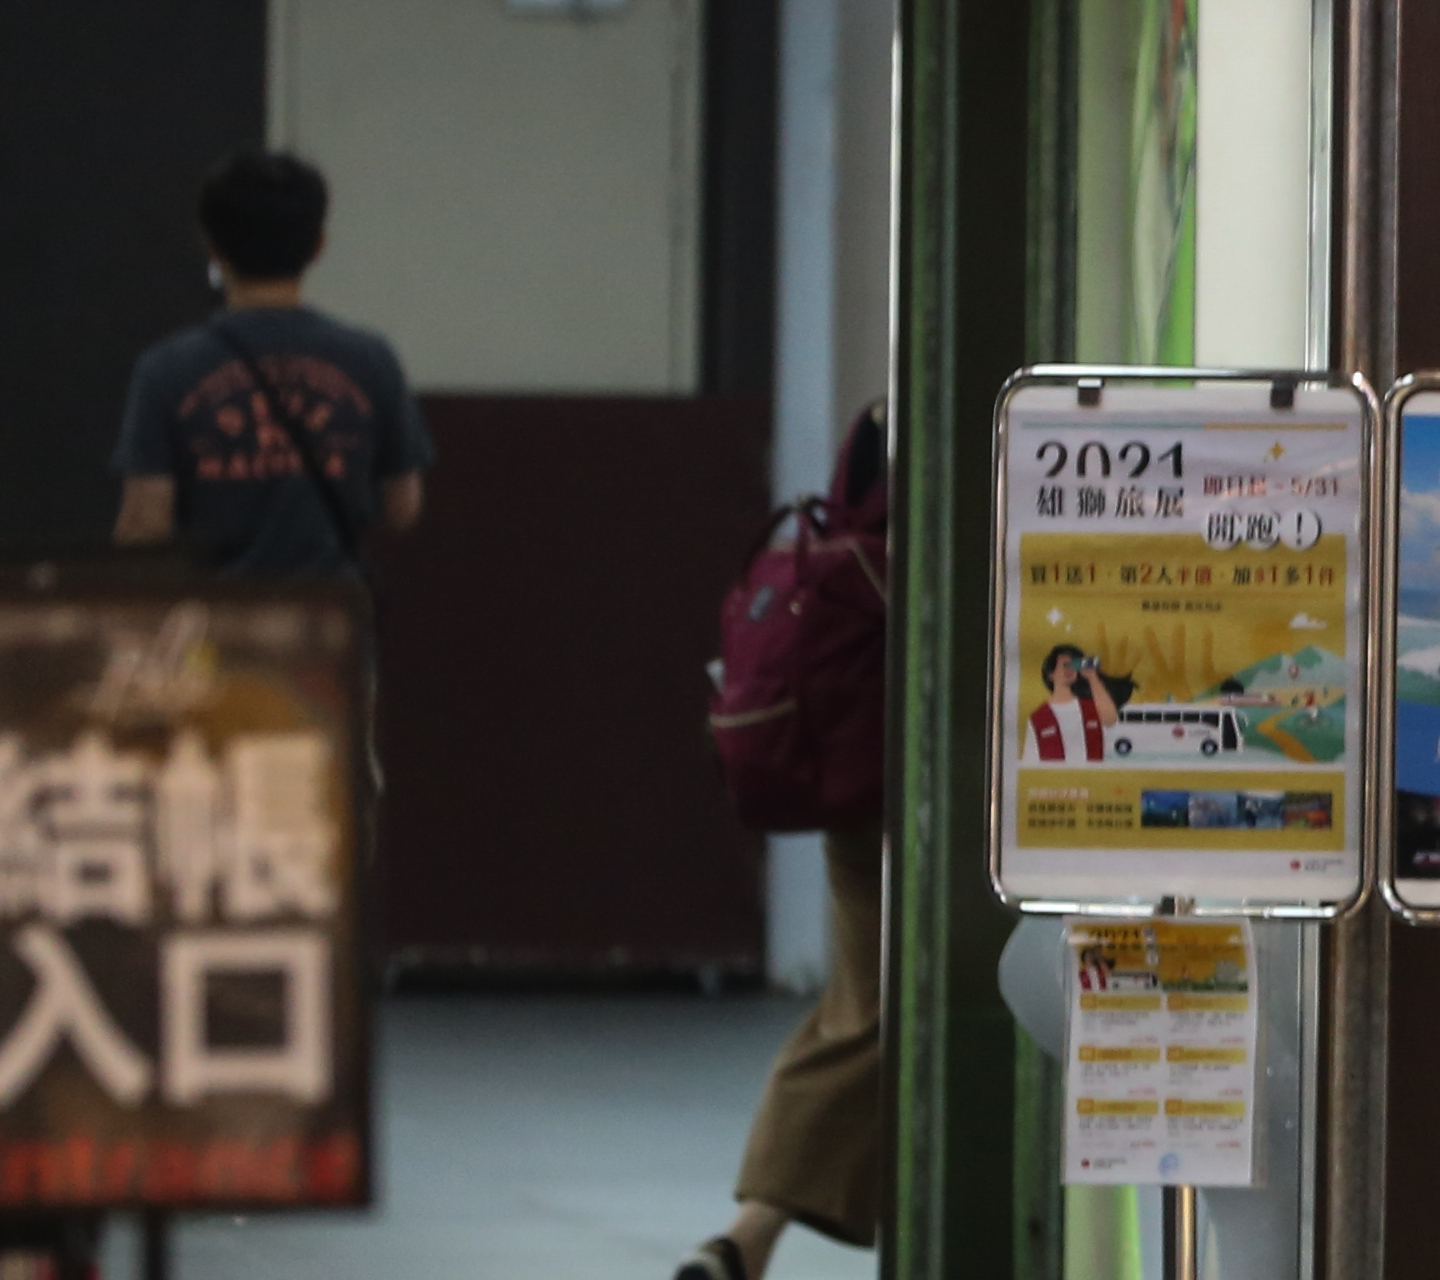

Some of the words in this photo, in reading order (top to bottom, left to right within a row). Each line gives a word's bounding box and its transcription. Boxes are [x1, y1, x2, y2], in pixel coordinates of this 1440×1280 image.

[1035, 440, 1185, 480] 2021
[1036, 483, 1186, 519] 雄獅旅展
[0, 922, 333, 1106] 入口
